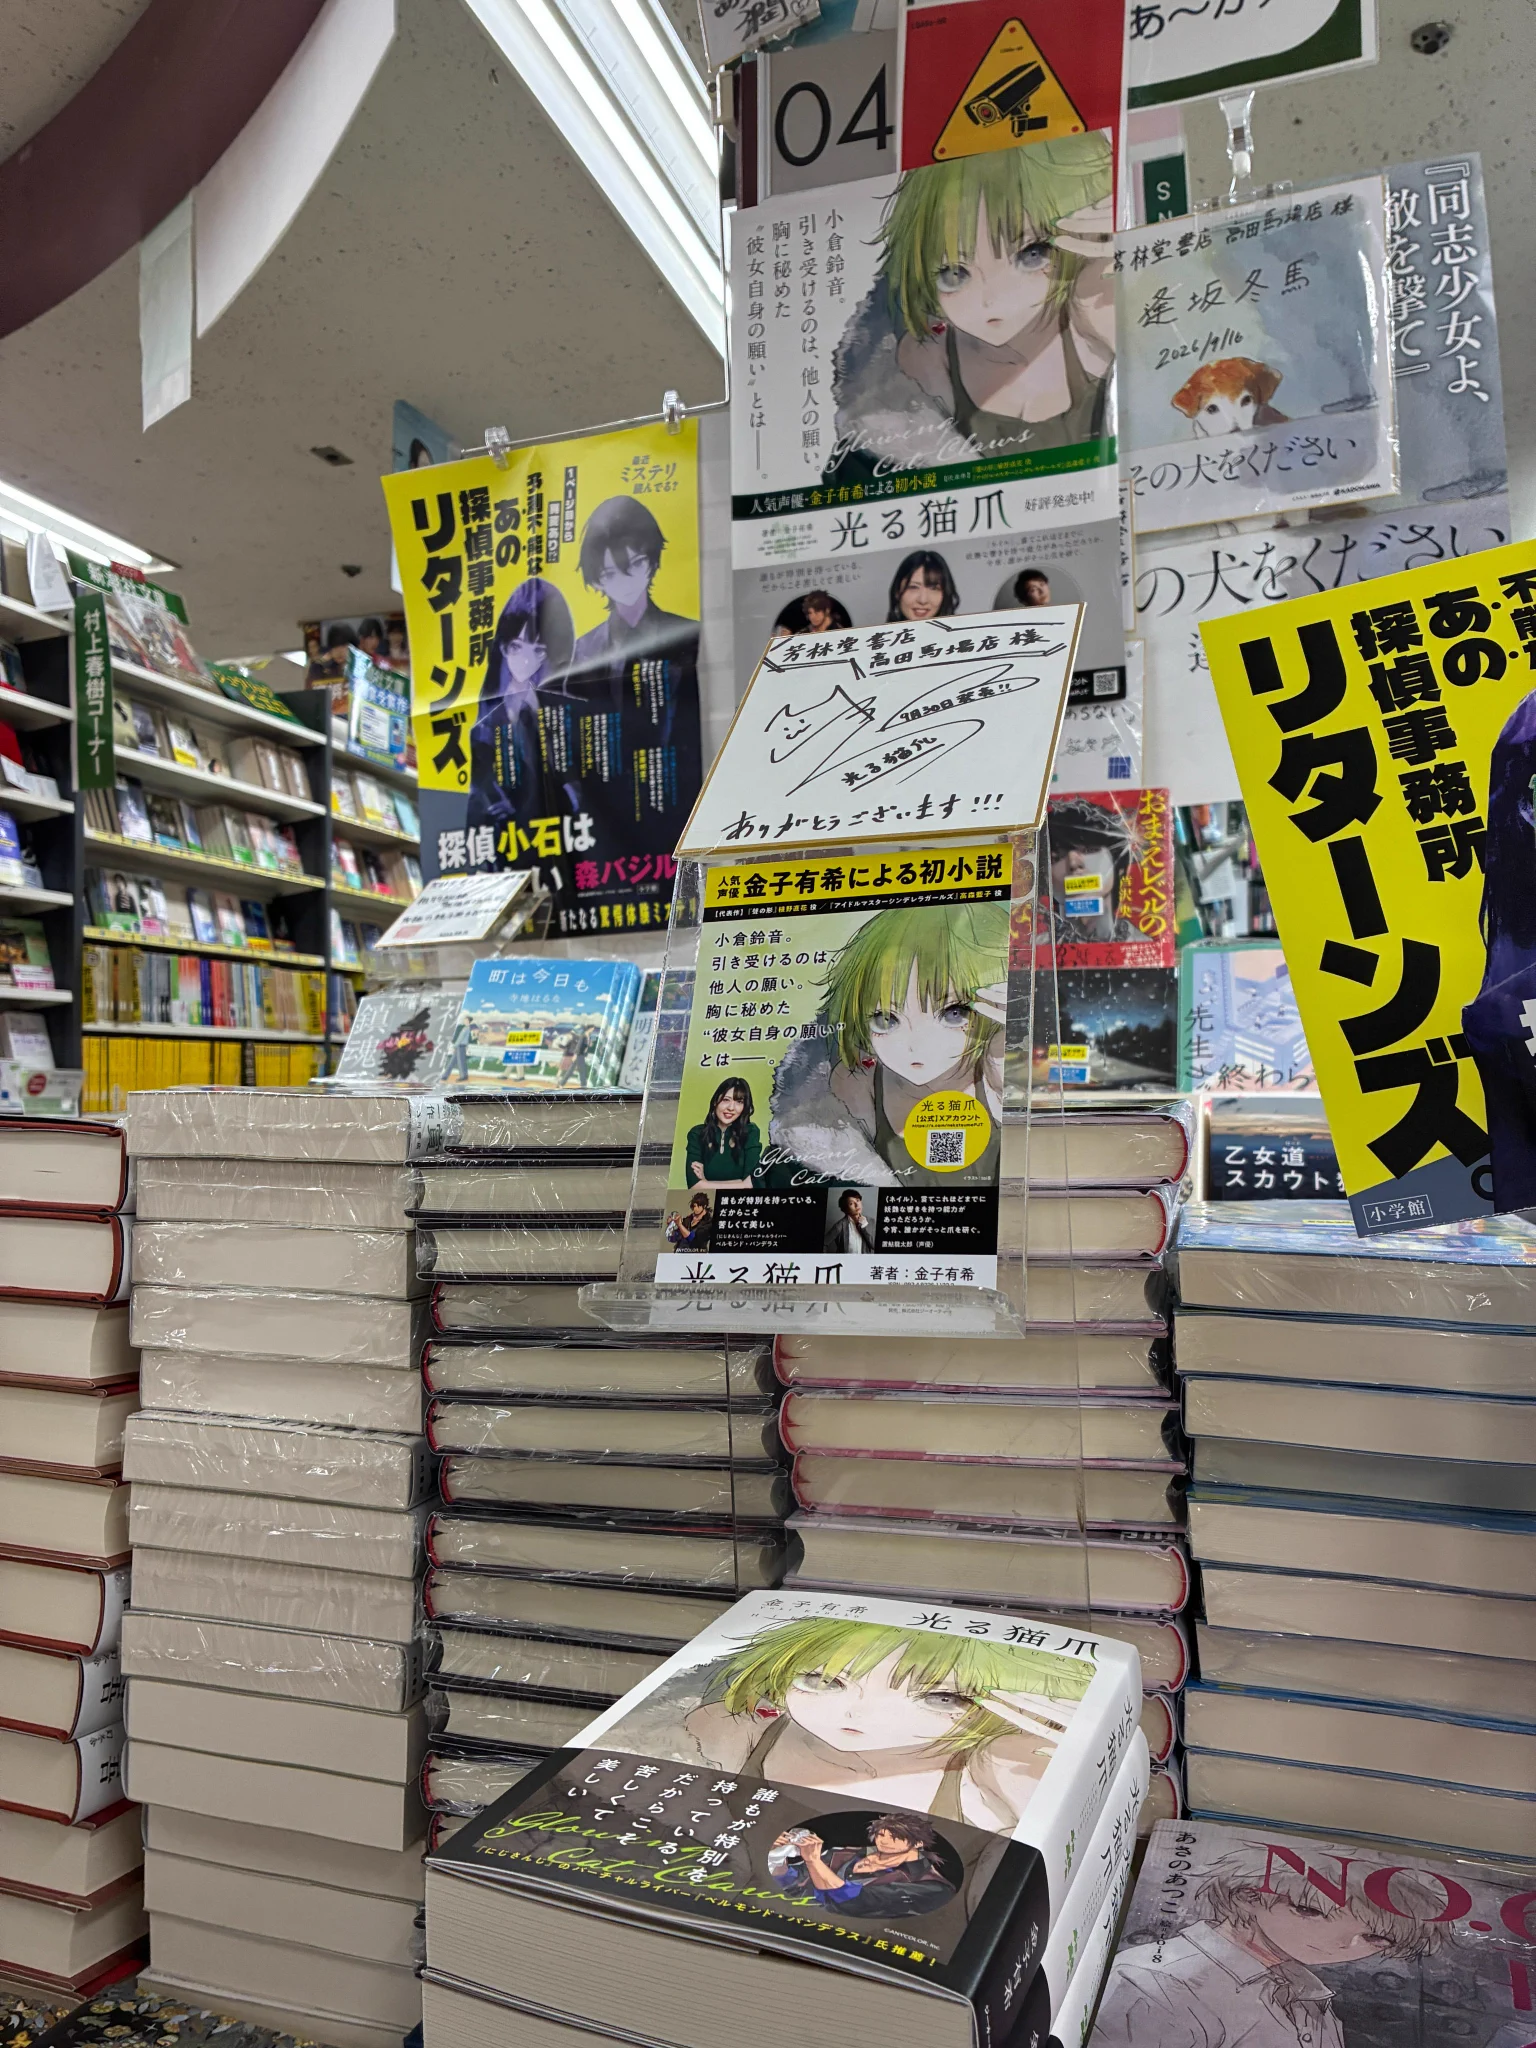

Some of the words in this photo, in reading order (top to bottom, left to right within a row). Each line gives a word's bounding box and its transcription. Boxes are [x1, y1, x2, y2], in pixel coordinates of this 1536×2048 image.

[774, 62, 895, 167] 04
[1331, 194, 1355, 217] 様
[772, 220, 791, 319] 胸に秘めた
[825, 208, 845, 305] 小倉鈴音。
[1138, 259, 1311, 328] 逢坂冬馬
[1424, 161, 1490, 403] 『同志少女よ、
[798, 215, 822, 473] 引き受けるのは、他人の願い。
[621, 463, 677, 483] ミステリ
[1129, 436, 1357, 497] その犬をください
[494, 498, 521, 569] あの
[830, 488, 1013, 552] 光る猫爪
[458, 486, 496, 668] 探偵事務所
[410, 491, 468, 787] リターンズ。
[782, 628, 917, 664] 芳林堂書店
[869, 635, 1001, 670] 高田馬場店
[1009, 628, 1051, 648] 様
[1423, 585, 1508, 688] あの
[83, 608, 105, 776] 村上春樹コーナー
[1350, 599, 1488, 883] 探偵事務所
[438, 812, 596, 871] 探偵小石は
[1137, 789, 1168, 937] おまえレベルの
[574, 853, 678, 891] 森バジル
[717, 887, 740, 900] 声優
[718, 875, 741, 887] 人気
[744, 853, 1004, 899] 金子有希による初小説
[1239, 619, 1495, 1202] リターンズ。
[711, 950, 839, 971] 引き受けるのは、
[714, 929, 793, 948] 小倉鈴音。
[488, 968, 591, 993] 町は今日も
[708, 976, 804, 995] 他人の願い。
[705, 1001, 791, 1020] 胸に秘めた
[341, 1001, 393, 1079] 鎮魂
[1217, 1063, 1316, 1091] 終わら
[921, 1100, 977, 1112] 光る猫爪
[790, 1168, 828, 1187] Cat
[841, 1162, 918, 1183] Claws
[1224, 1145, 1306, 1168] 乙女道
[718, 1220, 775, 1230] 苦しくて美しい
[719, 1208, 760, 1218] だからこそ
[720, 1196, 819, 1206] 誰もが特別を持っている、
[883, 1216, 936, 1224] あっただろうか。
[1370, 1198, 1427, 1222] 小学館
[869, 1266, 976, 1282] 著者：金子有希
[763, 1598, 869, 1614] 金子有希
[906, 1611, 1102, 1663] 光る猫爪
[567, 1757, 622, 1798] 美しい
[592, 1763, 659, 1822] 苦しくて
[617, 1772, 700, 1846] だからこそ
[658, 1779, 738, 1866] 持っている、
[687, 1787, 780, 1883] 誰もが特別を
[547, 1846, 660, 1874] Cat
[653, 1865, 826, 1907] Claws
[1160, 1831, 1198, 1916] あさのあつこ
